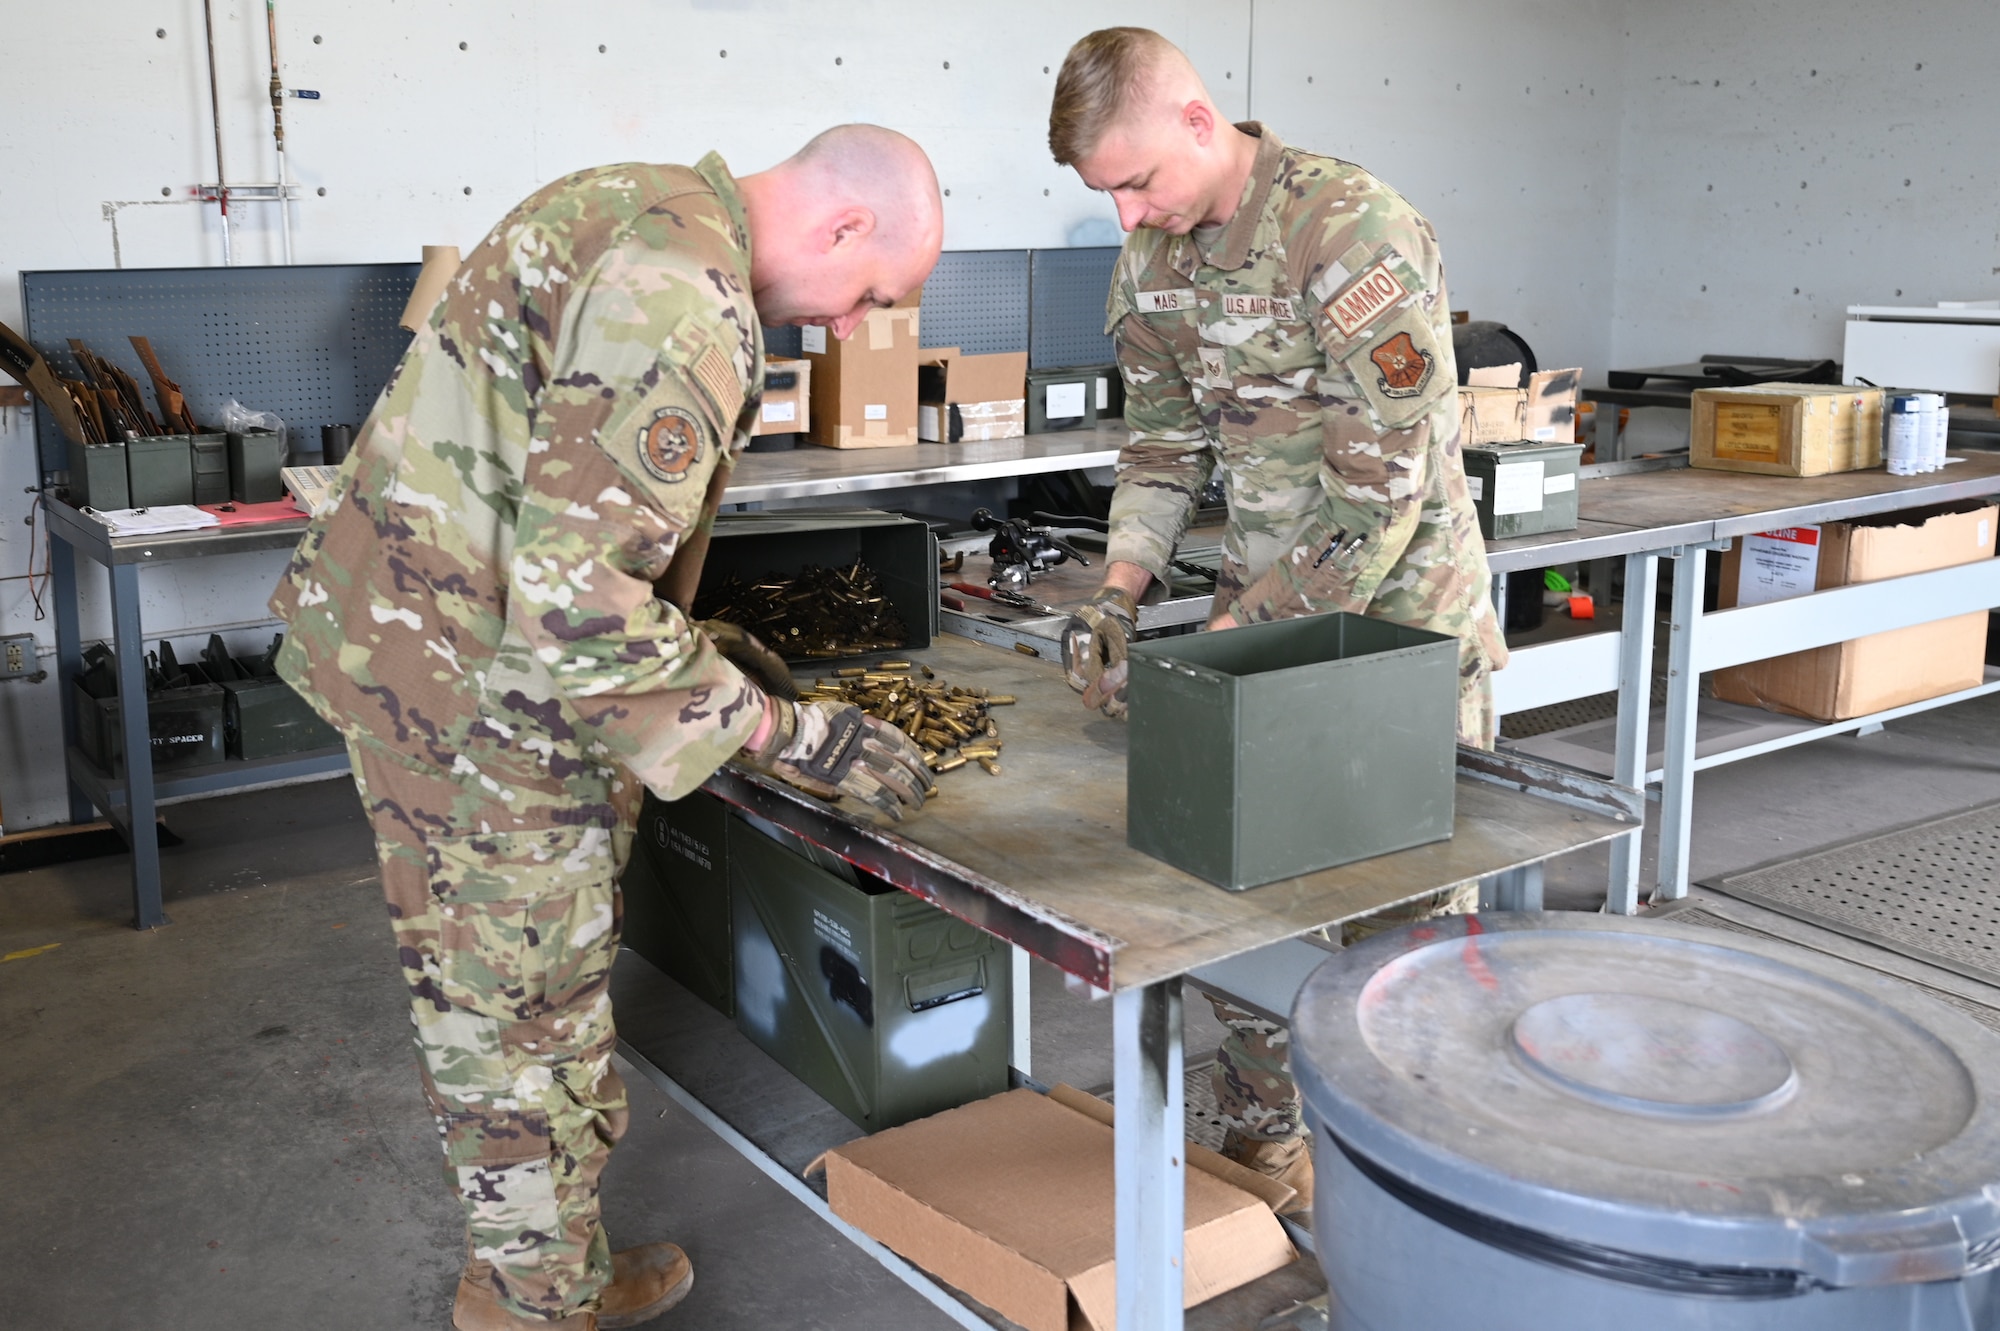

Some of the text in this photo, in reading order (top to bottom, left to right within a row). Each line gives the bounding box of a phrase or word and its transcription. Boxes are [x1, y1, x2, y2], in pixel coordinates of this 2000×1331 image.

[1154, 293, 1178, 310] MAIS
[1226, 298, 1248, 314] U.S.
[1249, 299, 1268, 315] AIR
[1335, 273, 1395, 329] AMMO
